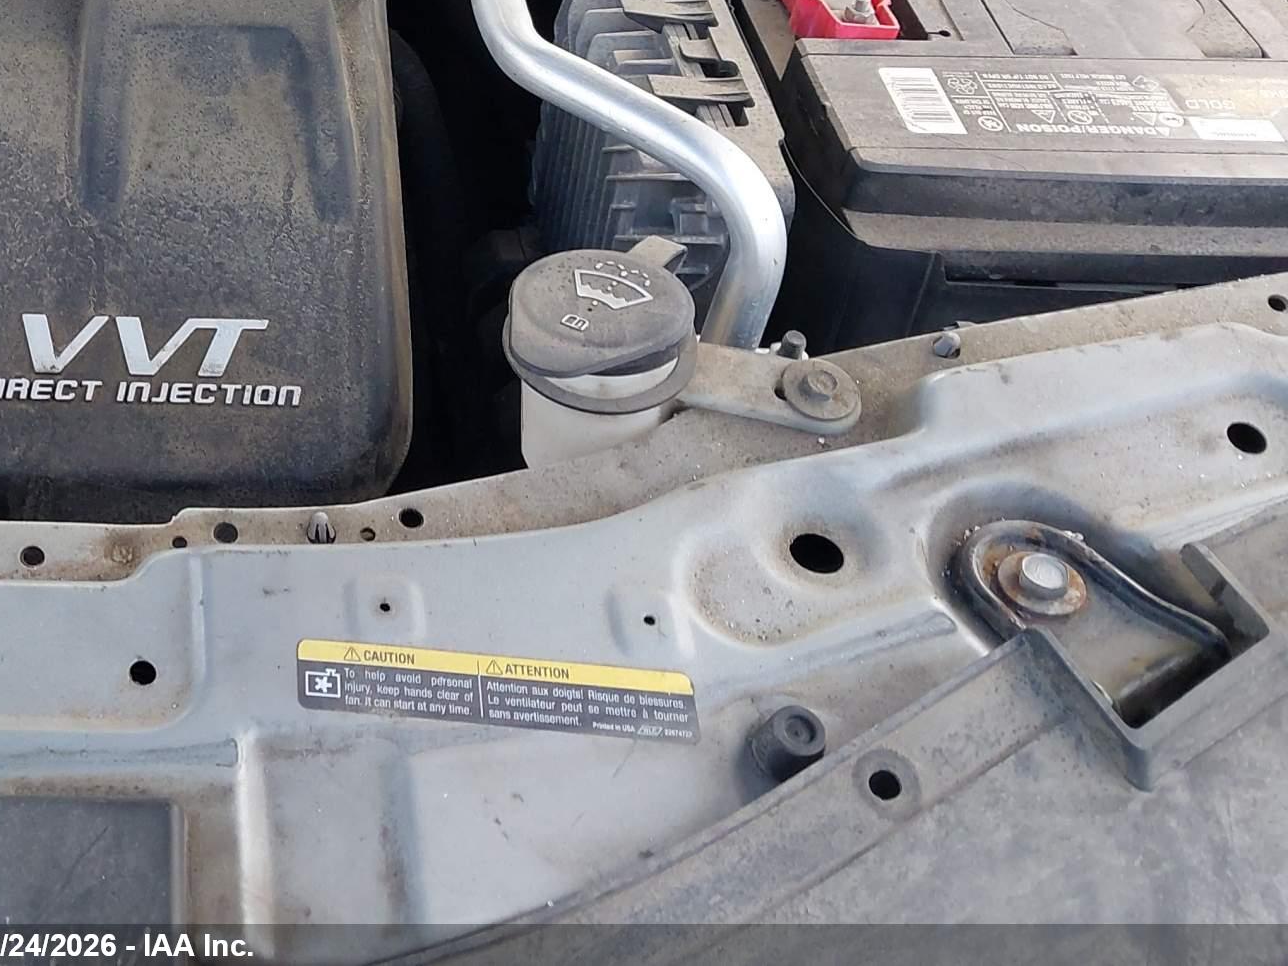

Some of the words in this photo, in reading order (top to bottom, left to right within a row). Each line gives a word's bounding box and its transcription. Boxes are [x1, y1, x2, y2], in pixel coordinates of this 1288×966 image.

[1016, 124, 1157, 135] DANGER/POISON
[21, 313, 269, 377] VVT
[116, 382, 302, 407] INJECTION
[364, 649, 415, 664] CAUTION
[344, 668, 355, 678] To
[365, 670, 386, 682] help
[396, 673, 421, 683] avoid
[431, 676, 473, 689] personal
[505, 664, 569, 679] ATTENTION
[344, 682, 373, 695] injury,
[377, 686, 400, 696] keep
[404, 687, 432, 698] hands
[437, 690, 460, 700] clear
[464, 692, 474, 702] of
[487, 681, 528, 694] Attention
[532, 686, 548, 695] aux
[553, 687, 584, 700] doigts!
[588, 690, 619, 703] Risque
[623, 694, 635, 704] de
[639, 695, 686, 709] blessures.
[345, 695, 362, 706] fan.
[365, 696, 373, 706] It
[374, 699, 391, 708] can
[394, 699, 414, 710] start
[417, 701, 427, 711] at
[429, 703, 447, 714] any
[448, 704, 473, 716] time.
[487, 694, 500, 705] Le
[505, 697, 555, 709] ventilateur
[561, 702, 583, 713] peut
[588, 705, 599, 714] se
[605, 706, 637, 718] mettre
[654, 710, 688, 723] tourner
[489, 709, 511, 720] sans
[513, 711, 582, 726] avertissement.
[622, 724, 635, 732] USA
